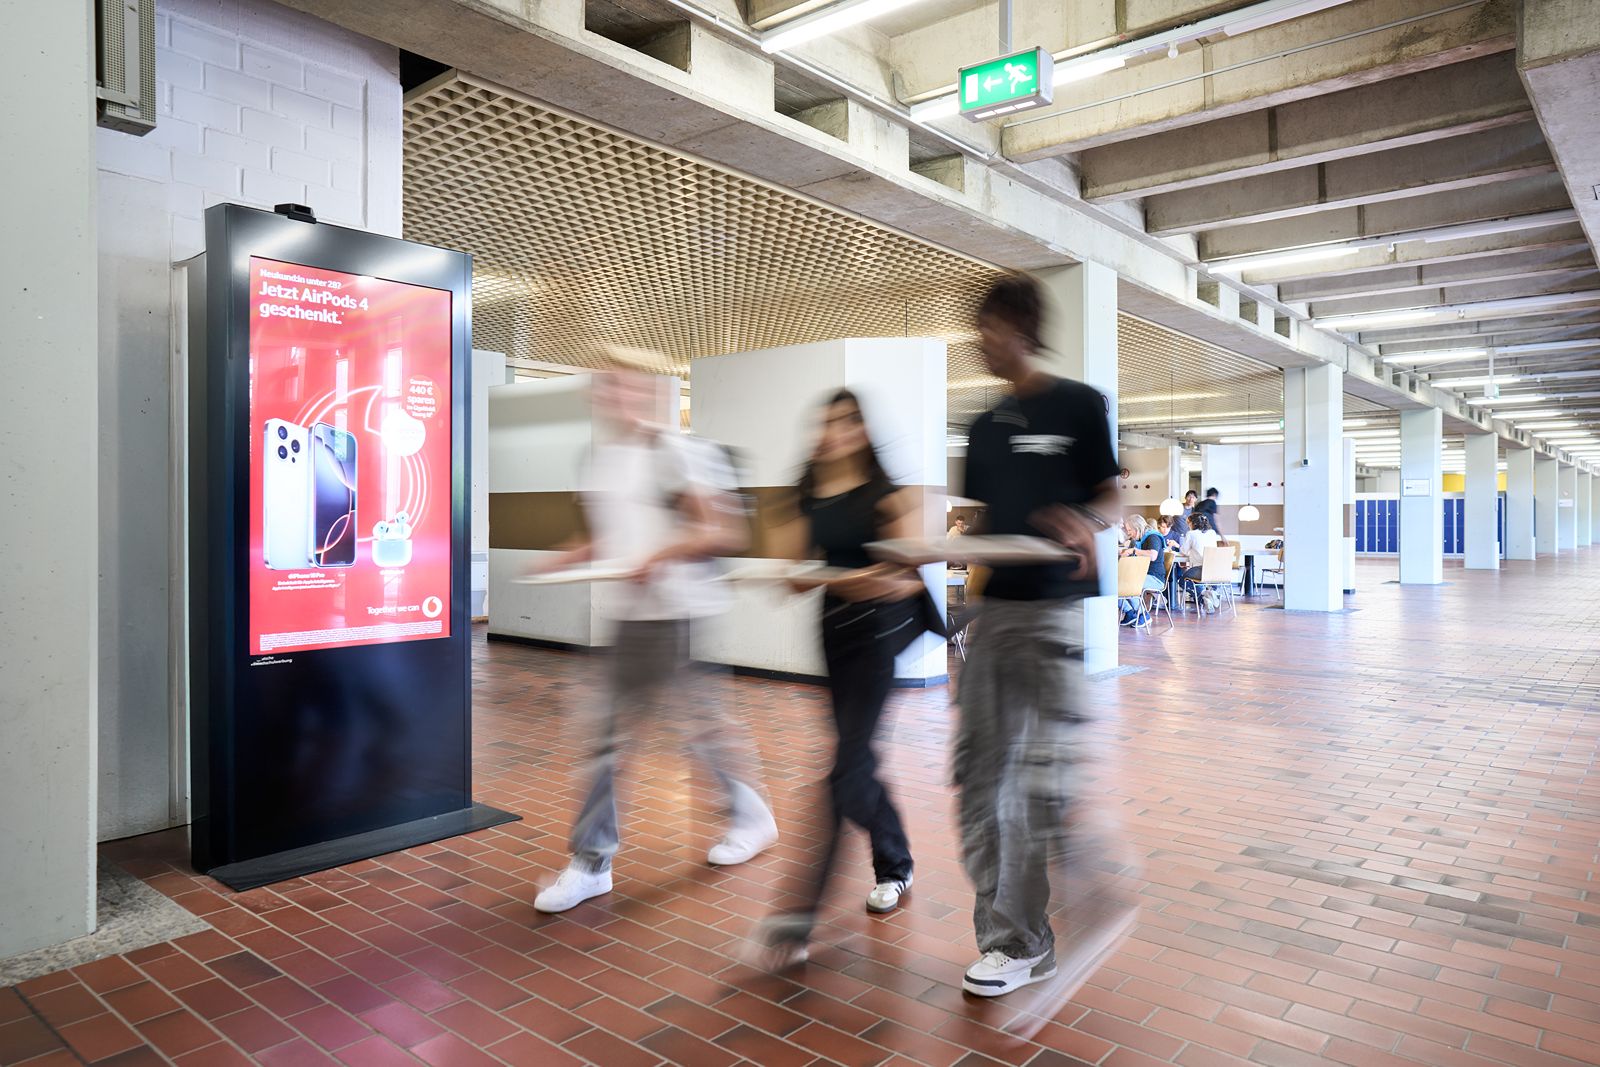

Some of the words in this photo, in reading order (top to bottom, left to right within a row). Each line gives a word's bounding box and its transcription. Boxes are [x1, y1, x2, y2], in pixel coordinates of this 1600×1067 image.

[306, 277, 328, 287] unter
[328, 280, 342, 289] 28?
[259, 280, 299, 301] Jetzt
[300, 287, 358, 309] AirPods
[358, 297, 369, 311] 4
[409, 385, 426, 395] 440
[367, 605, 397, 616] Together
[407, 604, 420, 612] can
